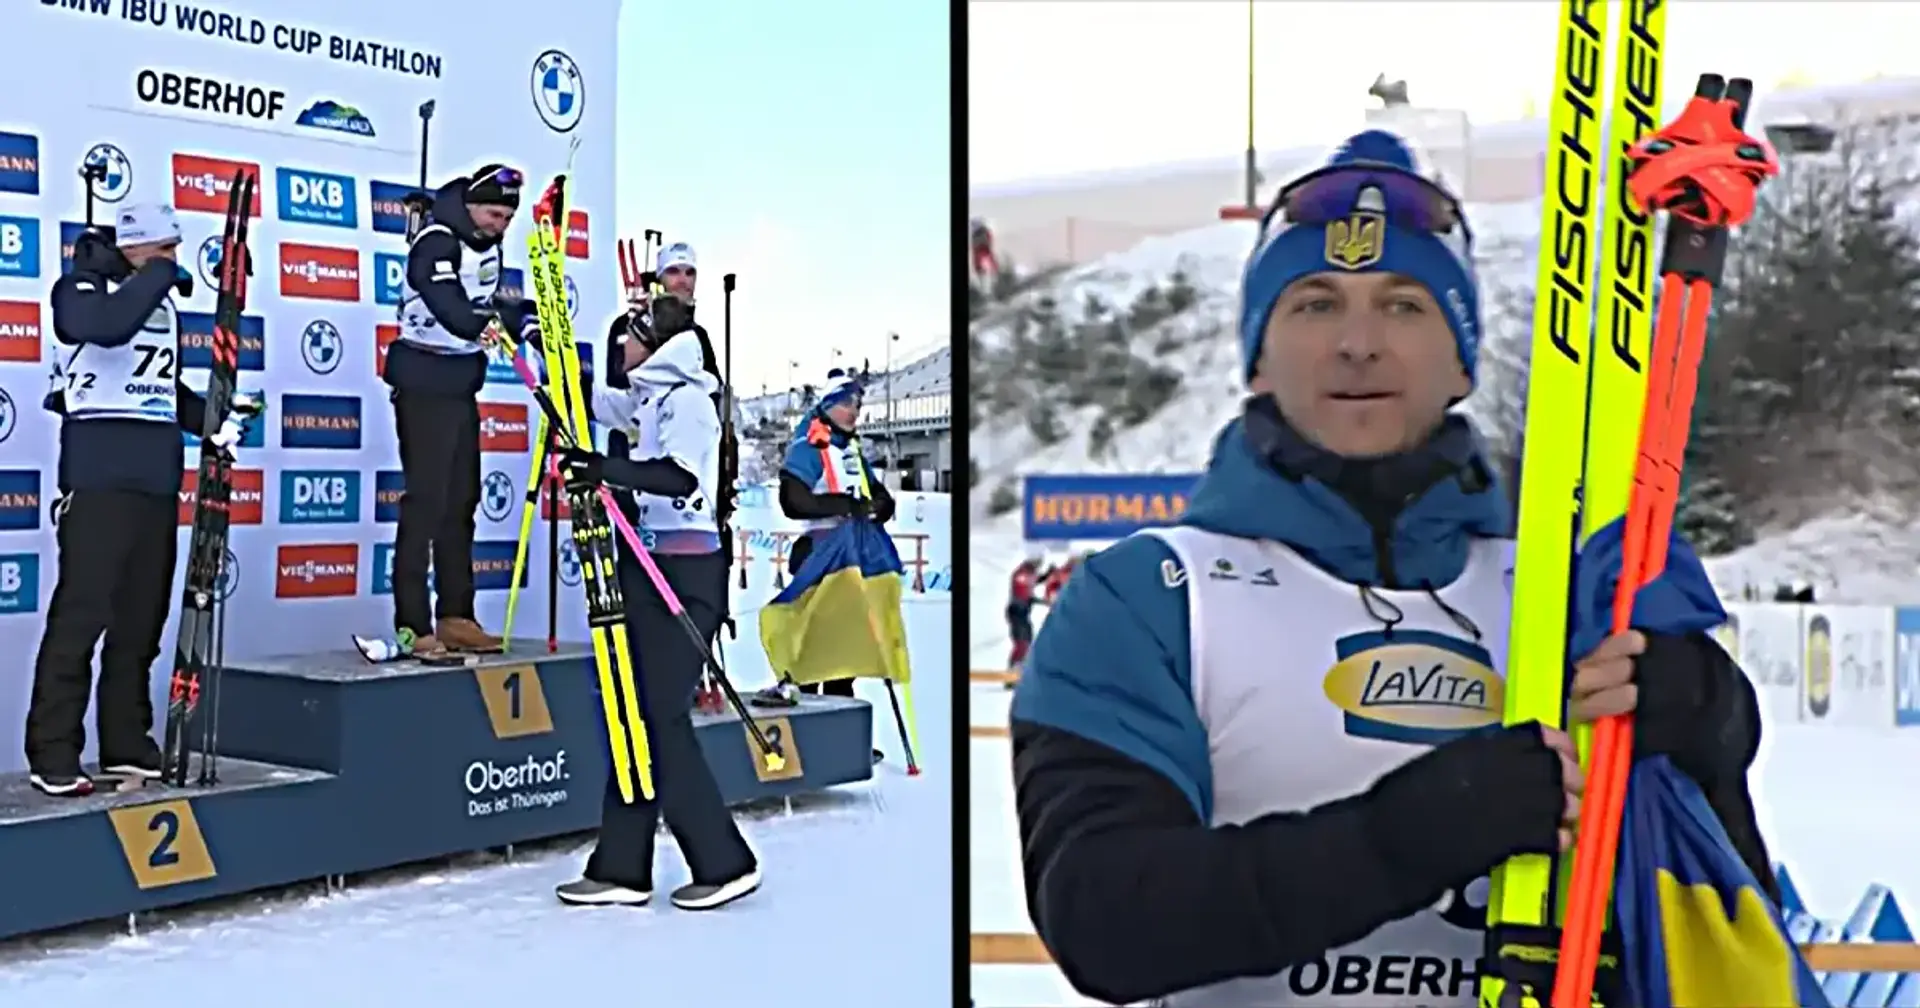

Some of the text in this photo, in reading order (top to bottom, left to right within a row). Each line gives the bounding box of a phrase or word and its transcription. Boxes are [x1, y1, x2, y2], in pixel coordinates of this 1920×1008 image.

[122, 0, 167, 26] IBU
[175, 5, 265, 44] WORLD
[273, 25, 322, 54] CUP
[329, 36, 442, 78] BIATHLON
[137, 70, 285, 120] OBERHOF
[290, 175, 344, 208] DKB
[132, 344, 175, 380] 72
[294, 476, 347, 504] DKB
[502, 671, 521, 719] 1
[465, 749, 571, 795] Oberhof.
[468, 800, 493, 817] Das
[148, 810, 180, 868] 2
